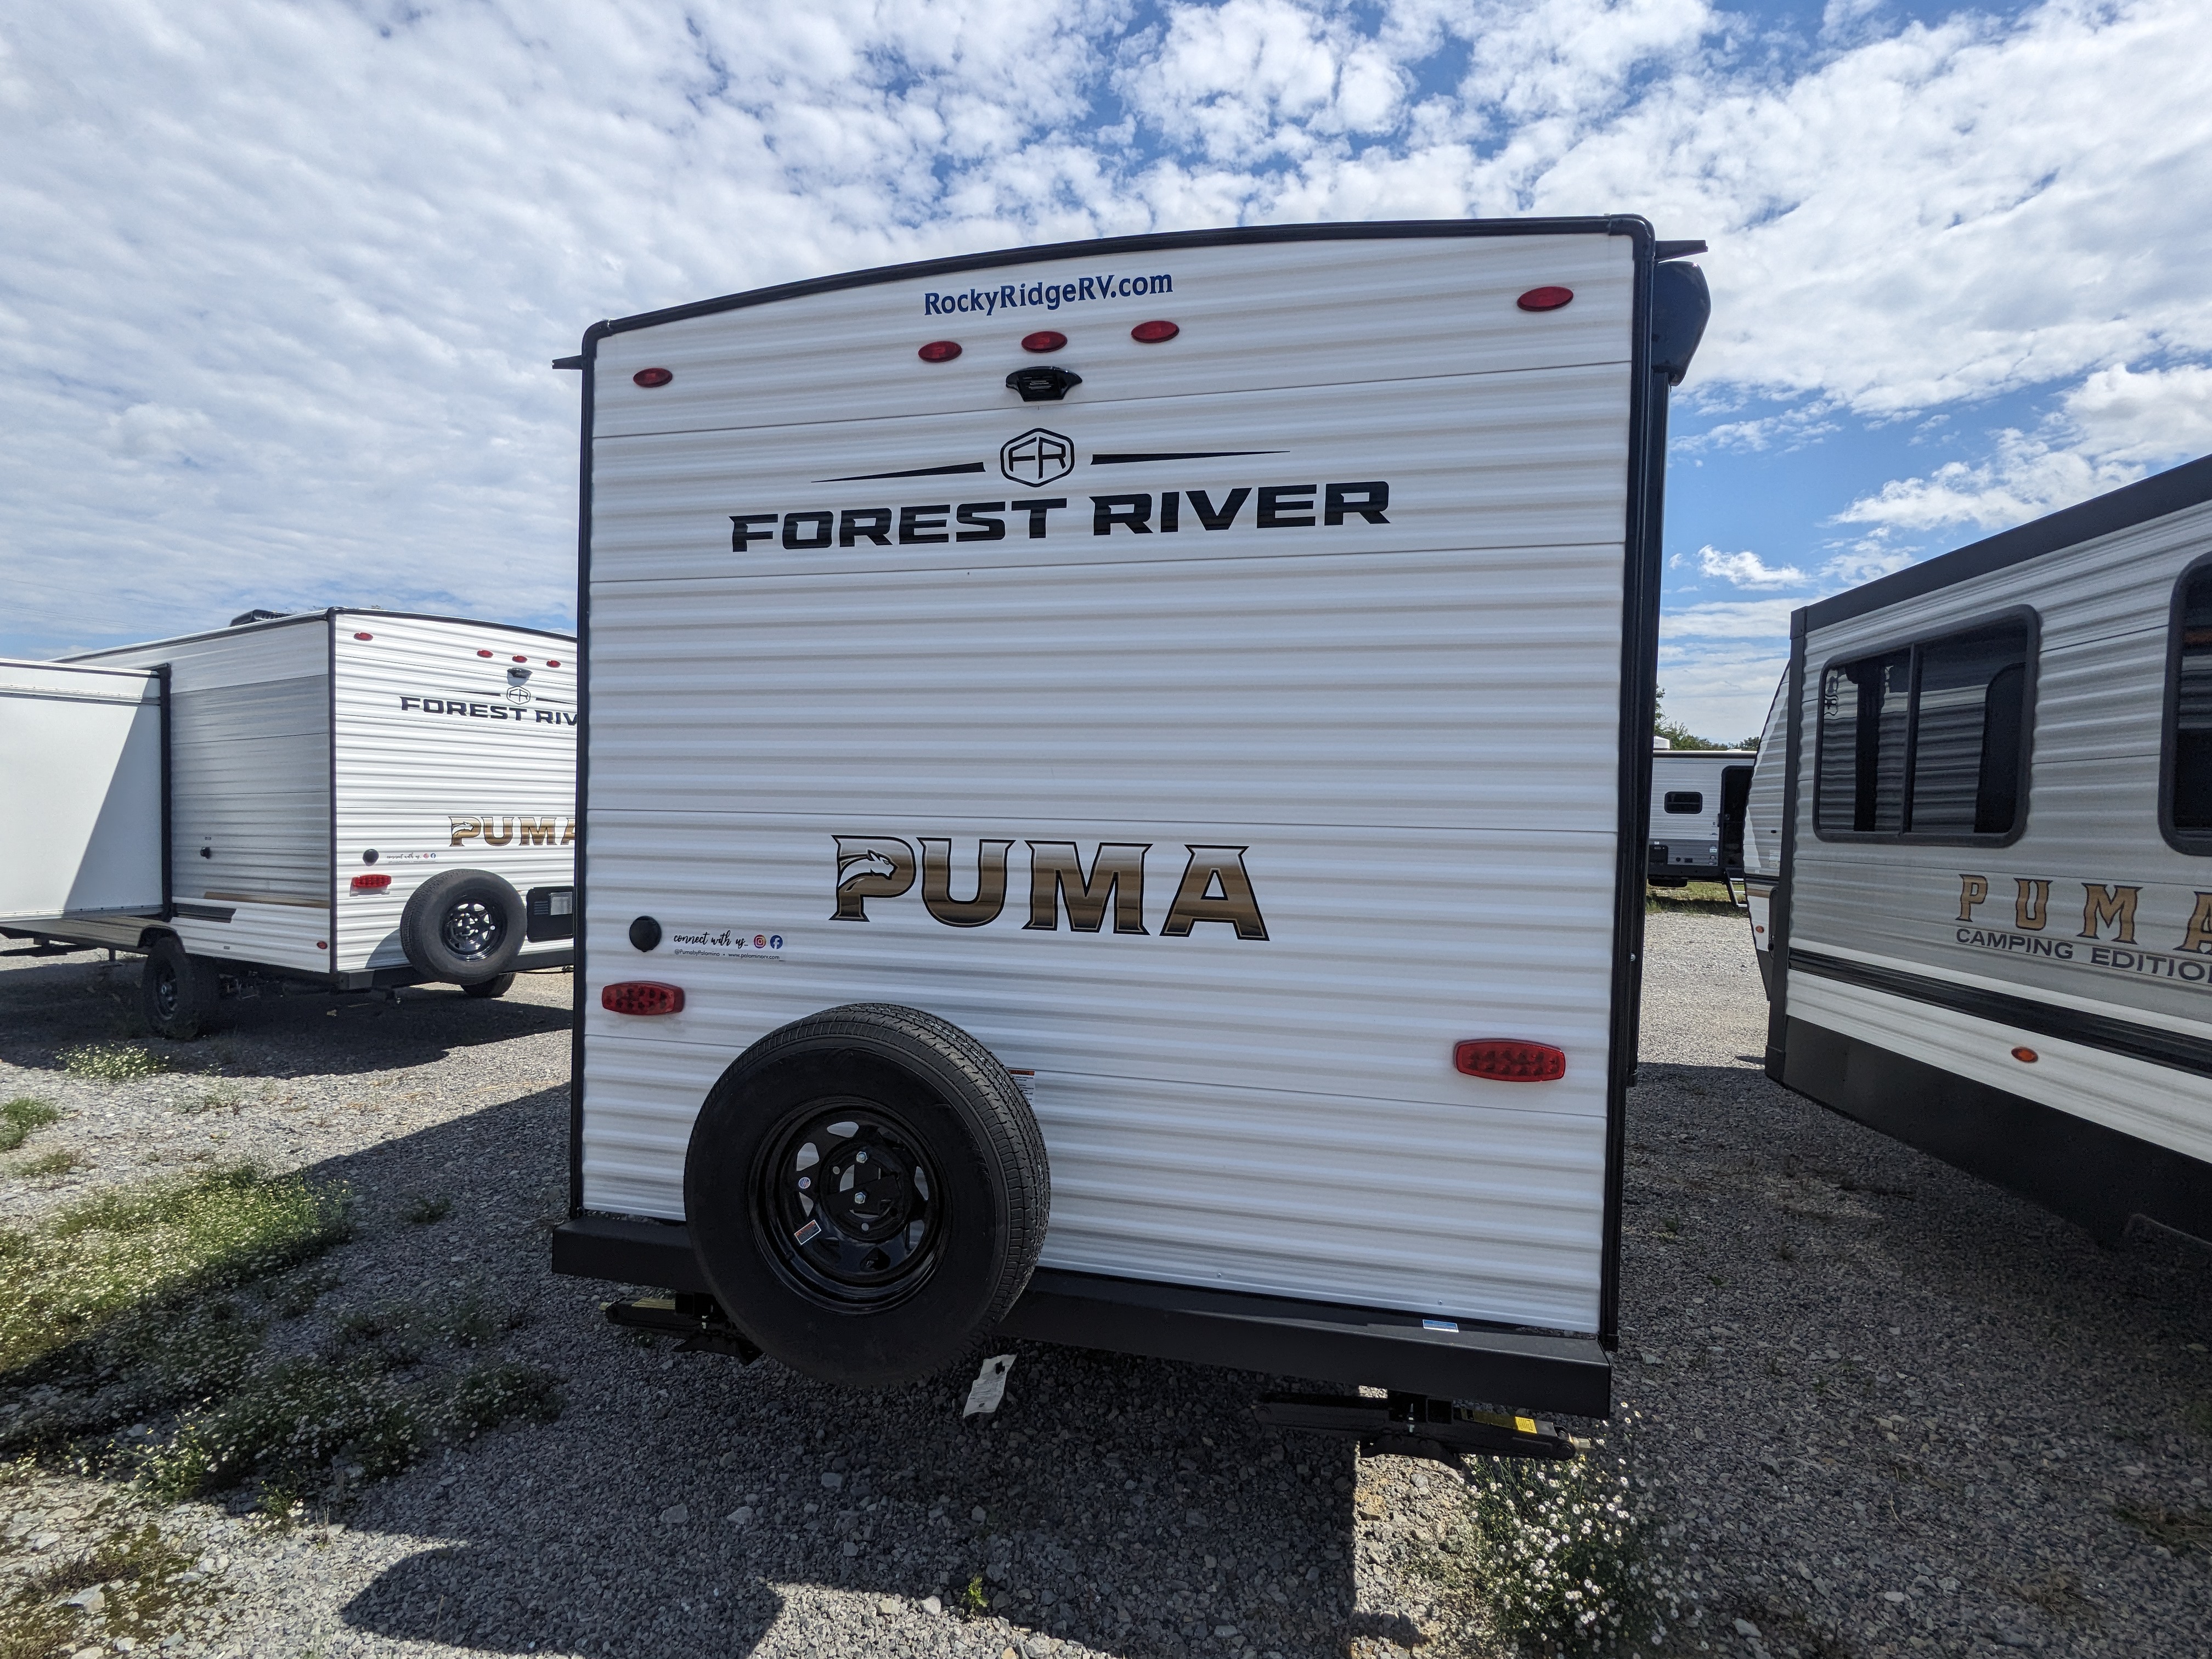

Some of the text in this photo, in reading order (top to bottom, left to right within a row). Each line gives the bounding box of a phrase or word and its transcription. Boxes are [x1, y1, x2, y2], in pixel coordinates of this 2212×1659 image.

[924, 274, 1173, 315] RockyRidgeRV.com
[729, 481, 1391, 552] FOREST RIVER
[399, 696, 527, 721] FOREST
[828, 834, 1270, 941] PUMA
[674, 932, 710, 945] connect
[711, 930, 731, 946] with
[1956, 928, 2073, 959] CAMPING
